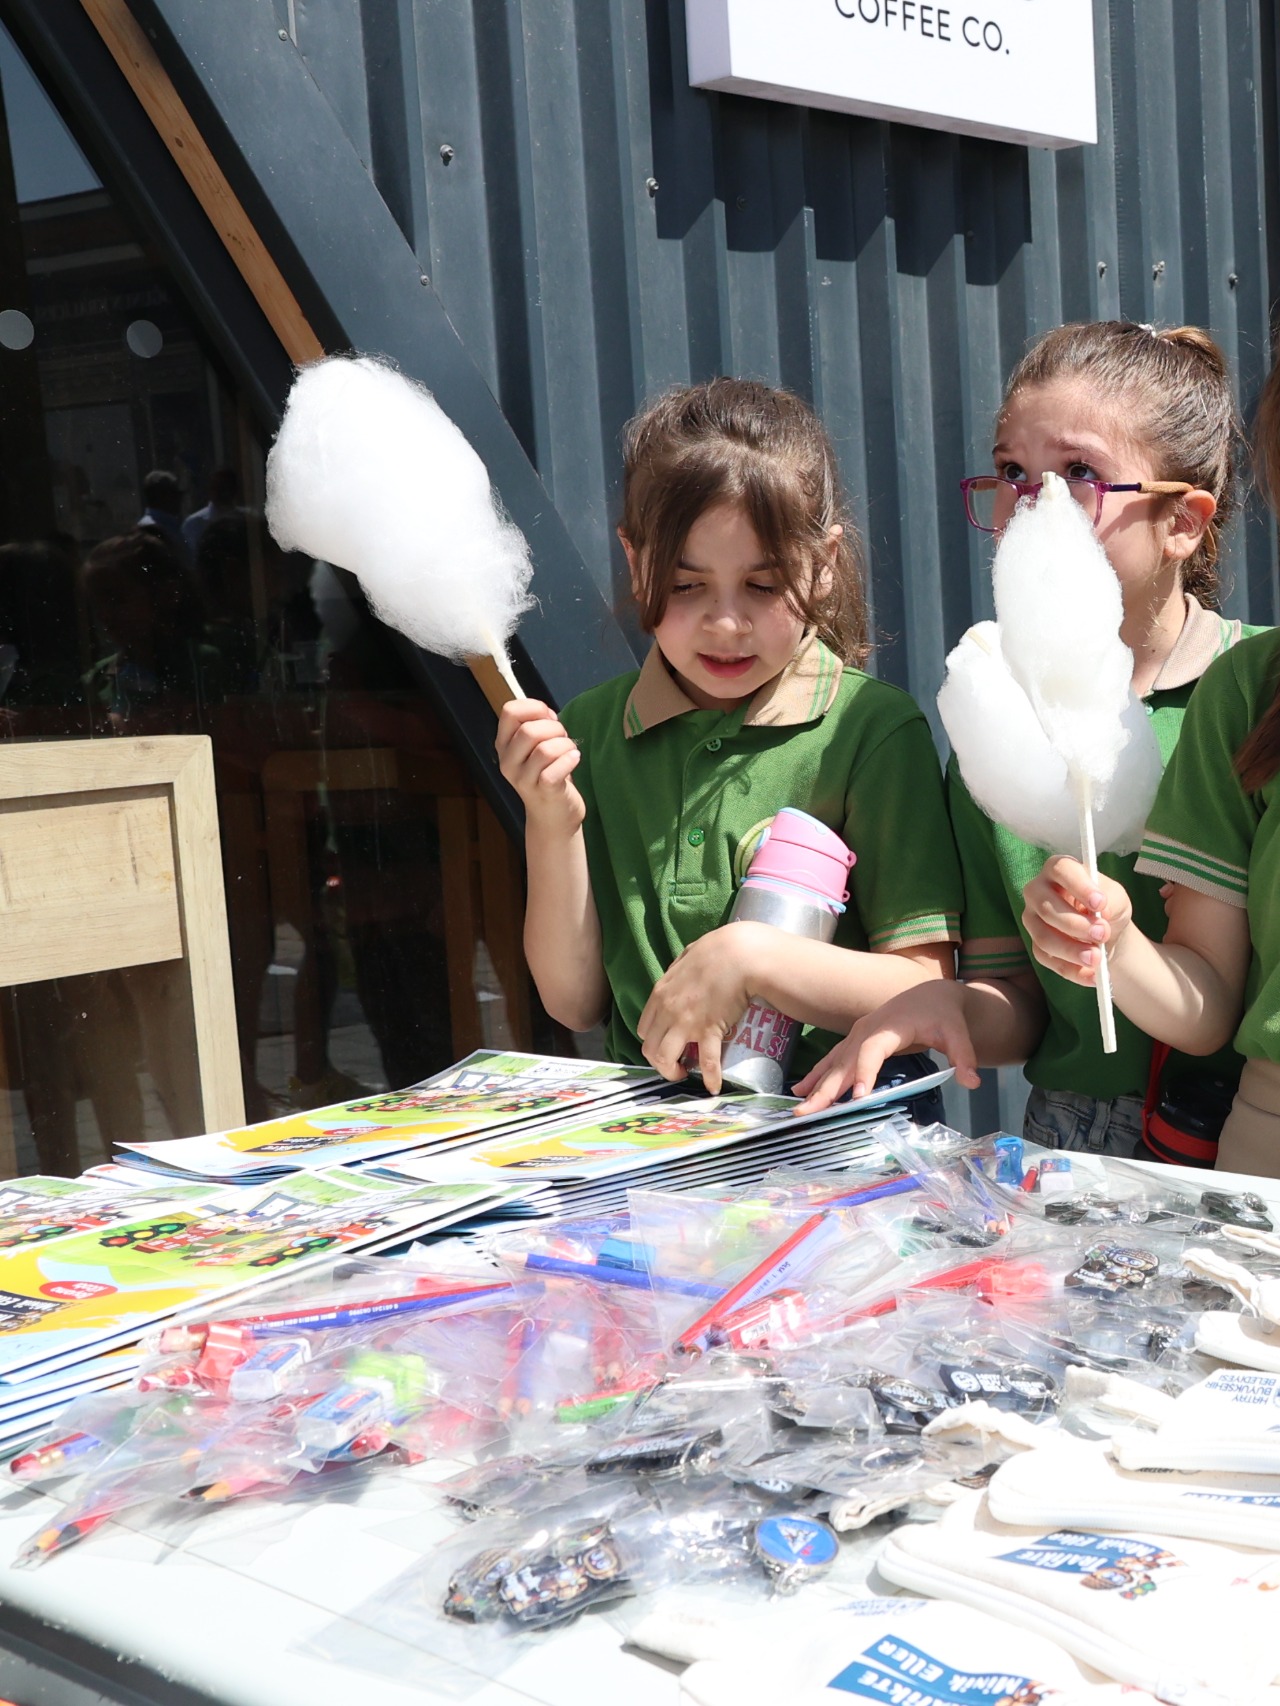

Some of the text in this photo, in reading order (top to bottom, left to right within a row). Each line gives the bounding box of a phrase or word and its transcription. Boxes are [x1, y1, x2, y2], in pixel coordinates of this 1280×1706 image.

[835, 0, 1010, 55] COFFEE CO.
[745, 1002, 794, 1038] TFIT
[1232, 1393, 1269, 1405] HATAY
[876, 1640, 1024, 1696] Minik Eller
